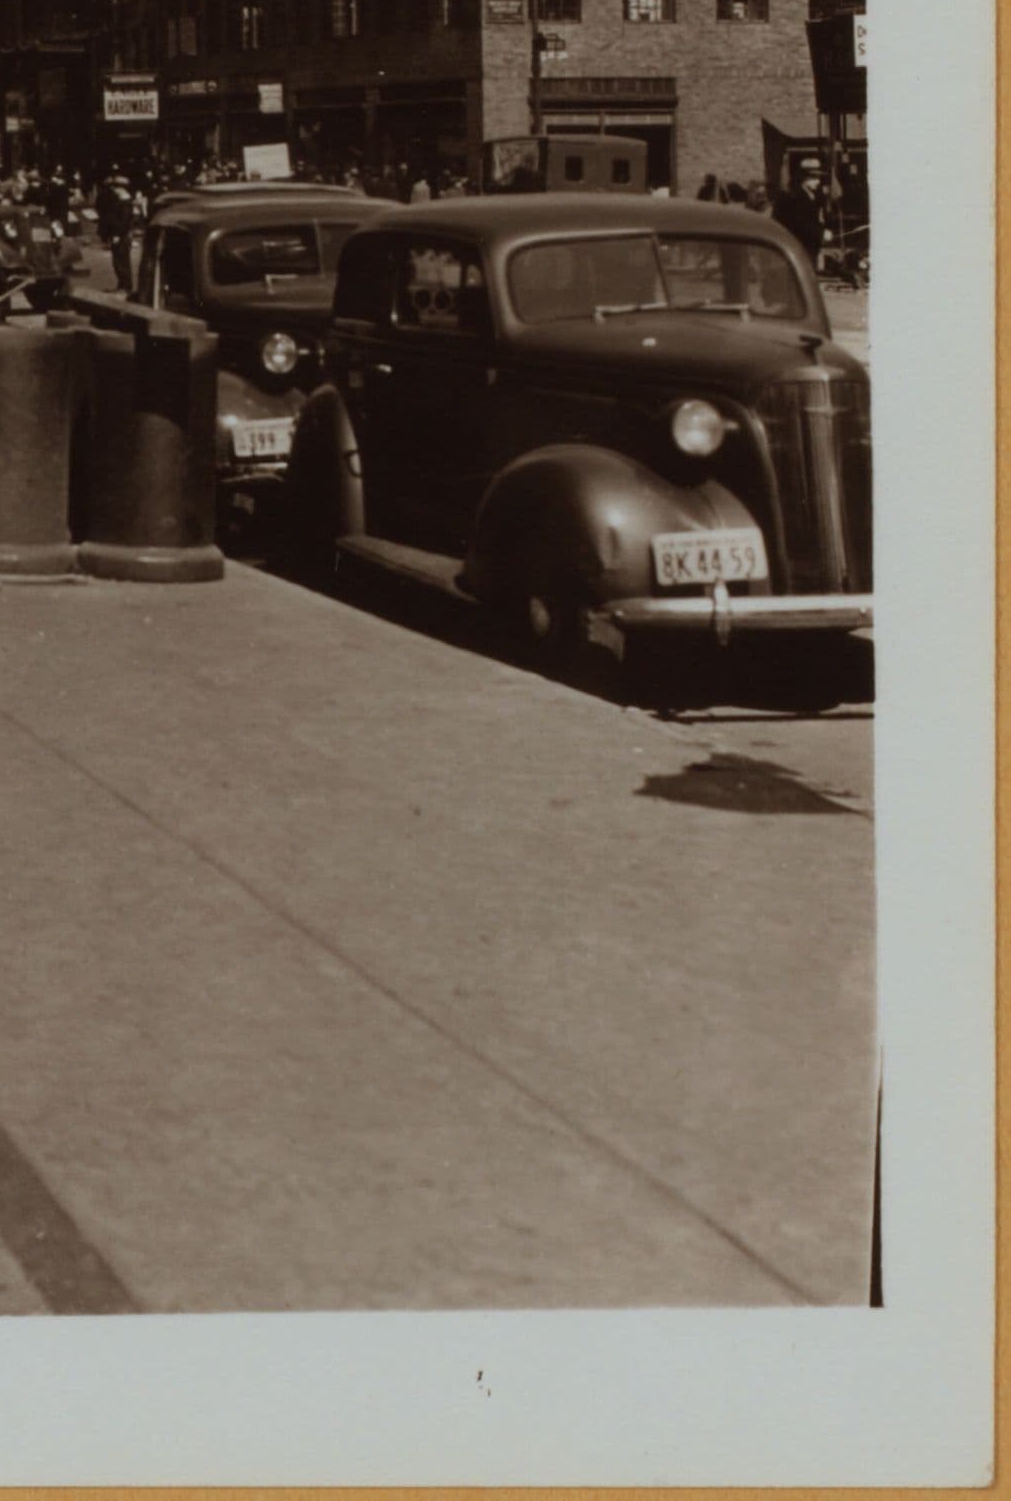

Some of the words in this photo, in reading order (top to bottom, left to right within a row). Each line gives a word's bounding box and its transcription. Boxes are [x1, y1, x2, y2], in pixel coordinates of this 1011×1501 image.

[107, 98, 156, 115] HARDWARE
[661, 551, 693, 579] 8K
[697, 548, 722, 575] 44
[729, 546, 757, 574] 59
